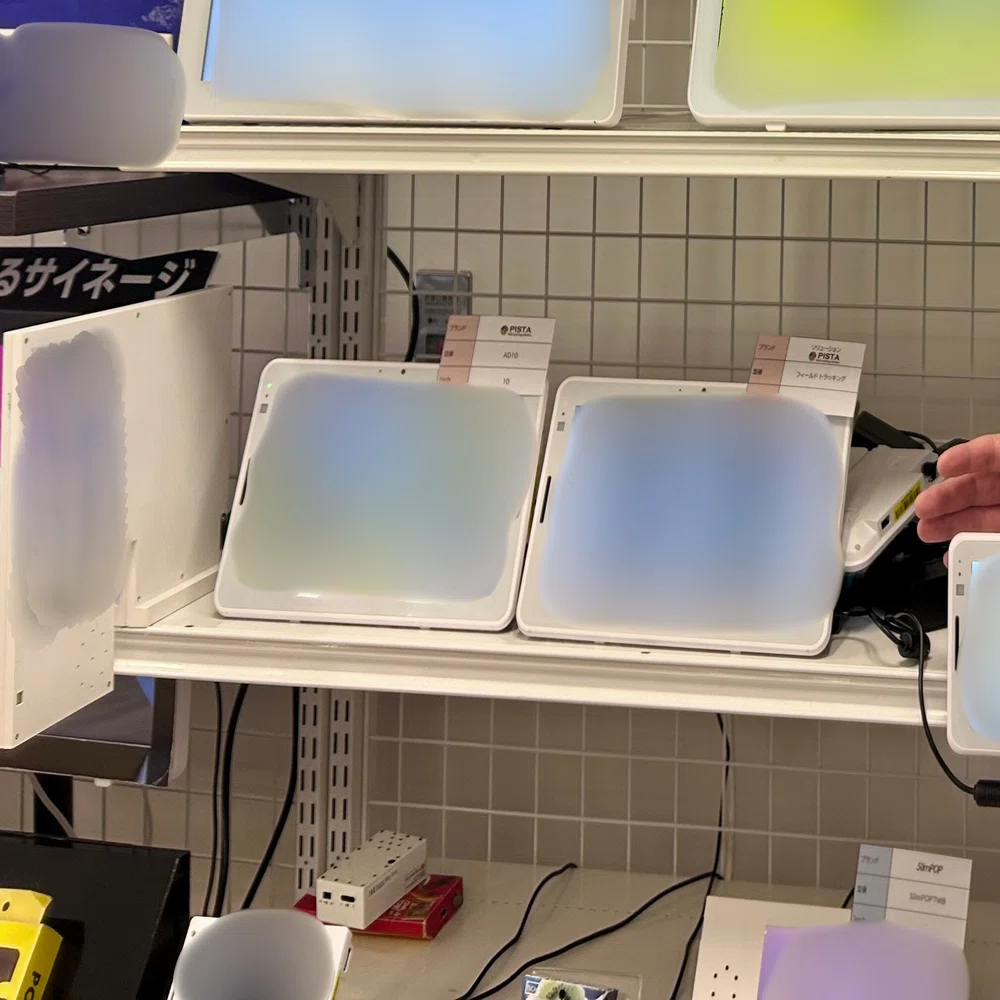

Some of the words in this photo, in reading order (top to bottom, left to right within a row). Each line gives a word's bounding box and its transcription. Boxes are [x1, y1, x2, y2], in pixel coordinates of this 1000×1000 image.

[509, 325, 532, 334] PISTA
[503, 351, 519, 359] AD10
[817, 352, 840, 361] PISTA
[916, 862, 944, 874] SlimPOP
